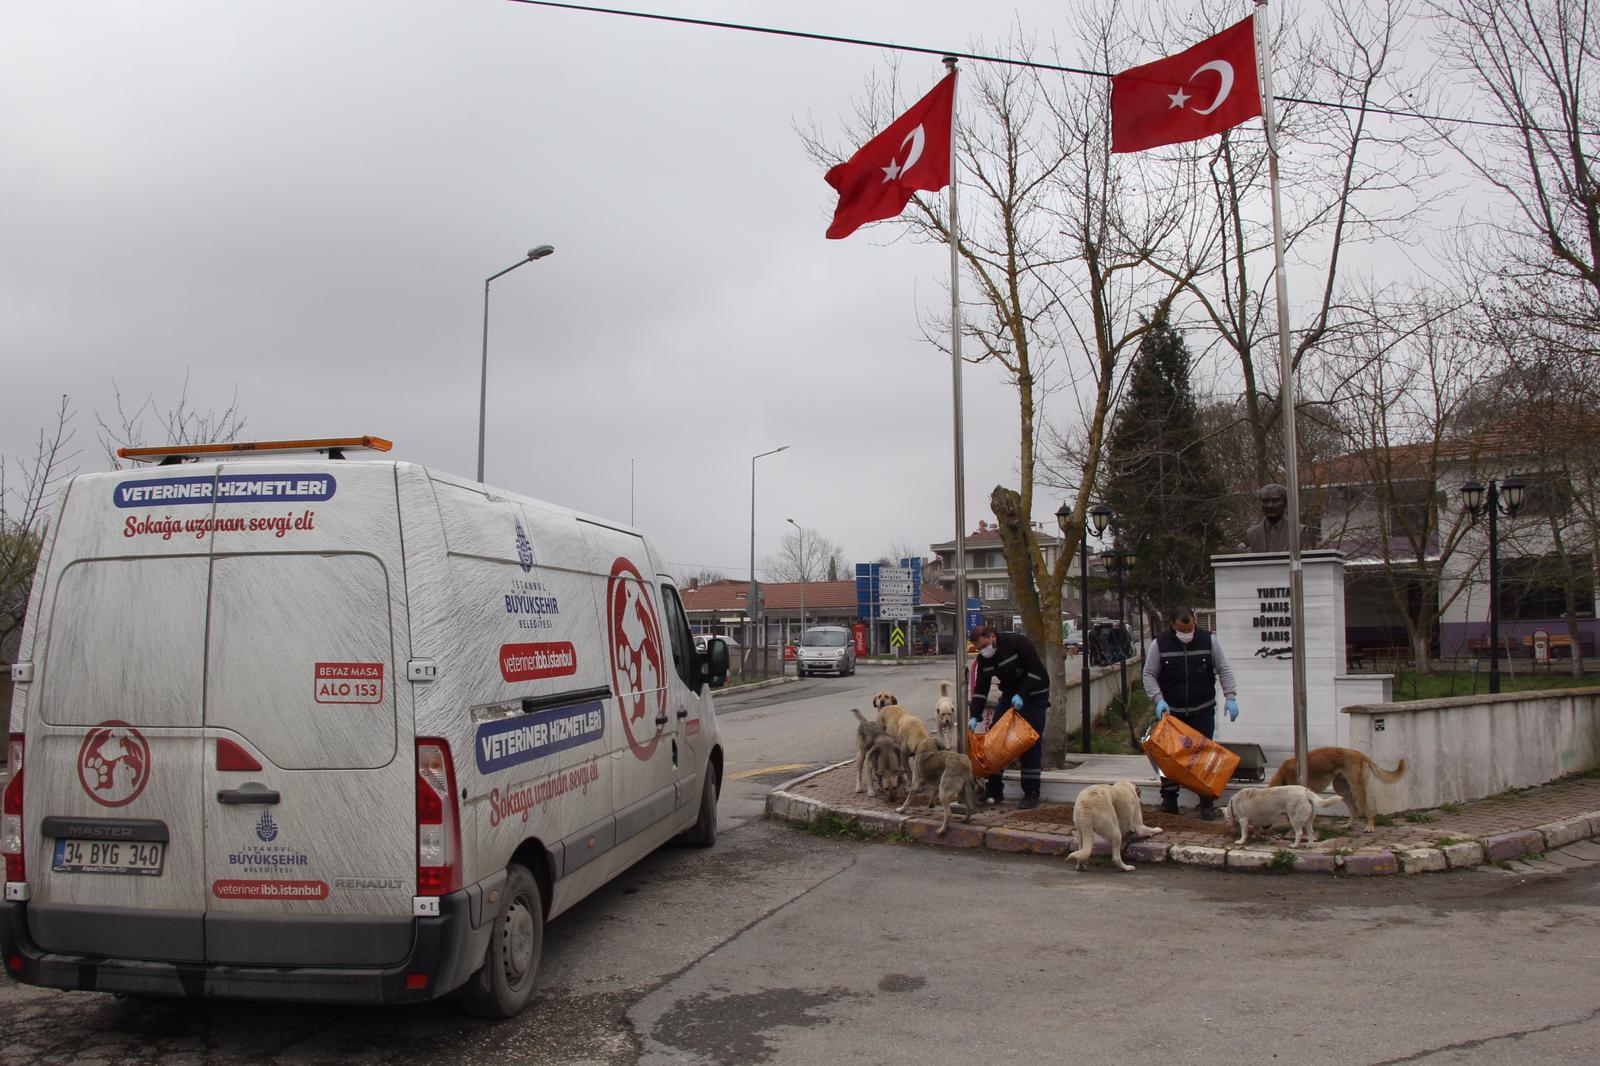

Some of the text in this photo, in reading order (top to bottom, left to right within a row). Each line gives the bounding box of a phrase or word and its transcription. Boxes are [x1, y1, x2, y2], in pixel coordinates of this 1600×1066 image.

[123, 510, 315, 540] Sokağa uzanan sevgi eli
[1256, 587, 1290, 599] YURTTA
[505, 589, 560, 619] BÜYÜKŞEHİR
[1260, 602, 1290, 613] BARIŞ
[1253, 616, 1292, 628] DÜNYAD
[1261, 631, 1290, 643] BARIŞ
[503, 648, 574, 673] veteriner.ibb.istanbul
[320, 667, 379, 676] BEYAZ MASA
[320, 683, 377, 697] ALO 153
[489, 754, 599, 827] Sokağa uzanan sevgi eli
[69, 826, 134, 837] MASTER
[65, 843, 83, 863] 34
[90, 843, 120, 864] BYG
[128, 844, 159, 866] 340
[229, 852, 308, 867] BÜYÜKŞEHİR
[217, 885, 322, 896] veteriner.ibb.istanbul
[335, 879, 405, 890] RENAULT
